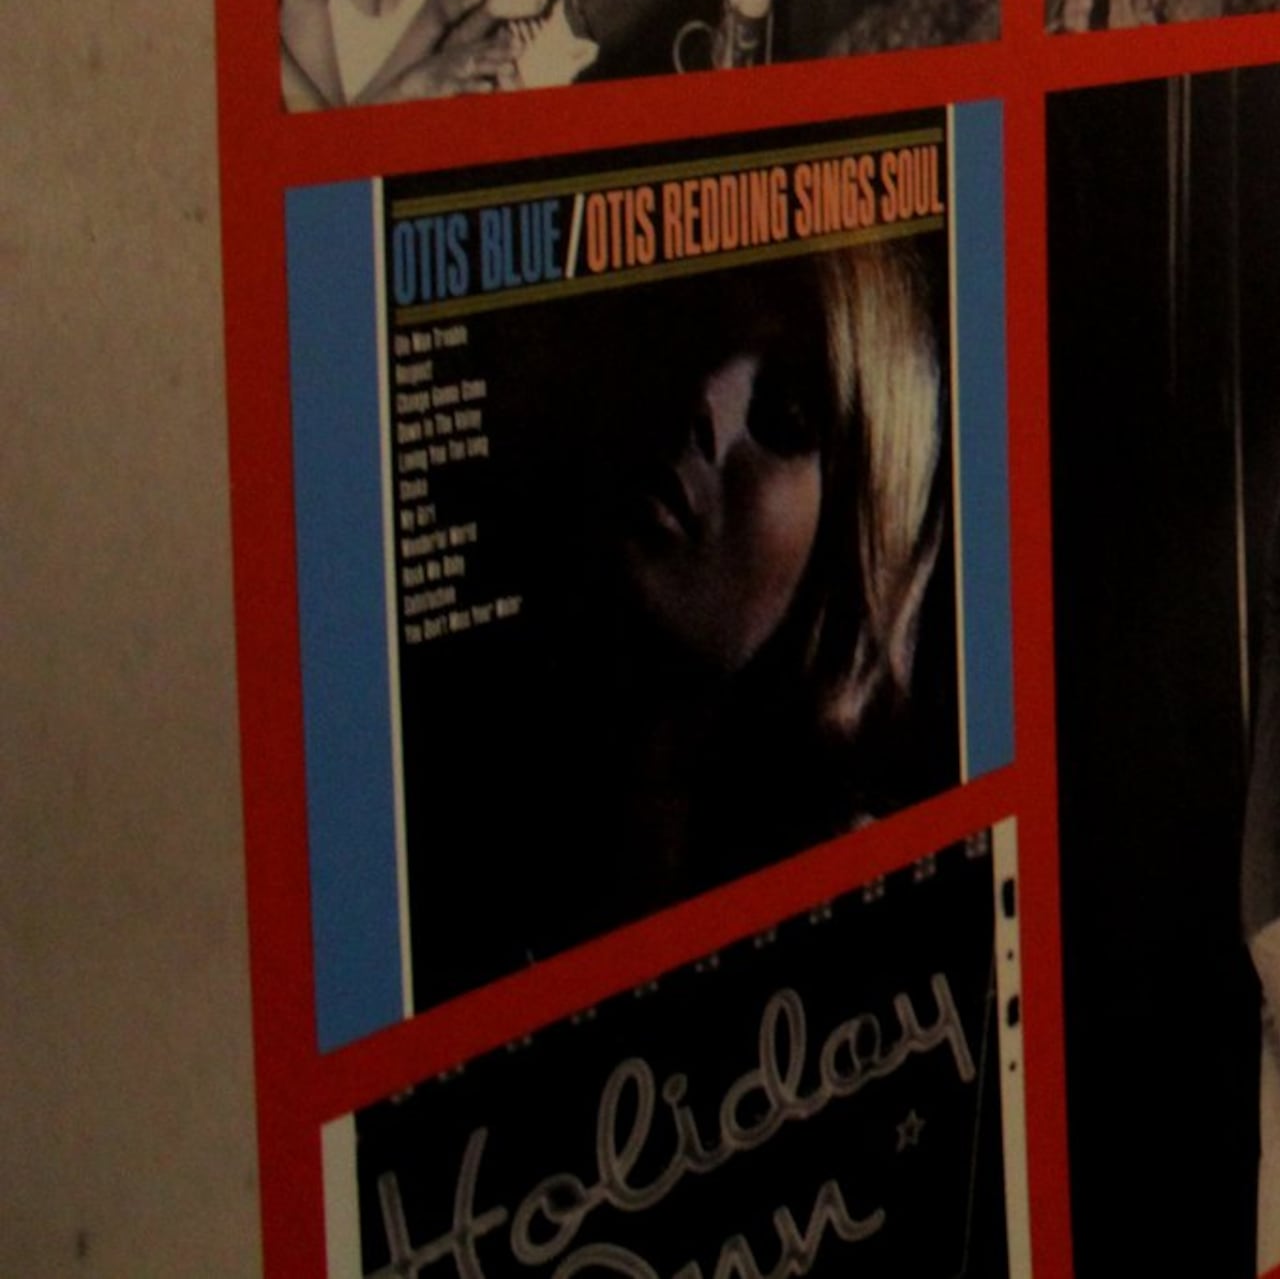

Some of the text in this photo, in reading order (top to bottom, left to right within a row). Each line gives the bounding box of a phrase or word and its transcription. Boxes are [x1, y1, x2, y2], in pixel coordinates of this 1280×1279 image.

[392, 212, 470, 305] OTIS
[662, 167, 788, 261] REDDING
[794, 154, 875, 238] SINGS
[880, 144, 944, 222] SOUL
[361, 972, 976, 1279] Holiday
